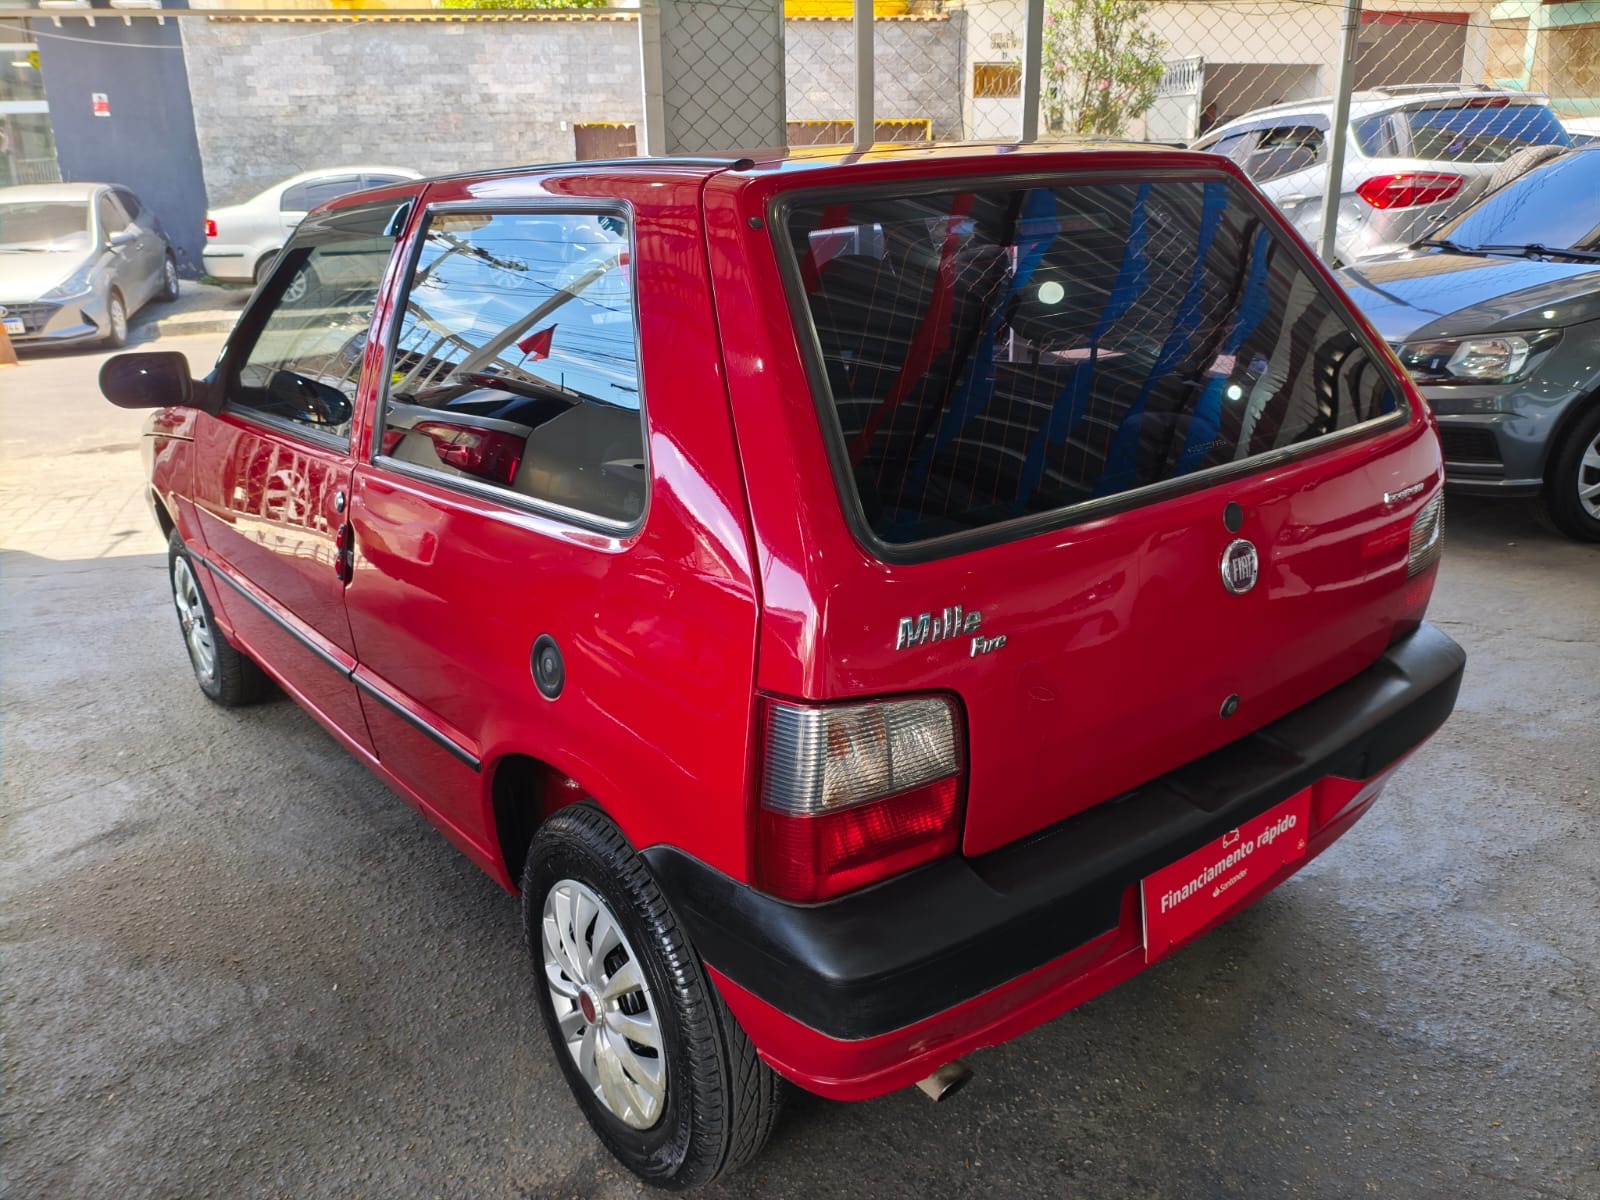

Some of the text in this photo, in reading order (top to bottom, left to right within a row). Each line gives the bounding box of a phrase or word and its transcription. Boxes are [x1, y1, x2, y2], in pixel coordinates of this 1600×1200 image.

[1231, 554, 1253, 582] FIAT
[895, 605, 983, 650] Mille
[970, 634, 1007, 658] Fire
[1160, 814, 1297, 914] Financiamento rápido
[1219, 868, 1249, 894] Santander
